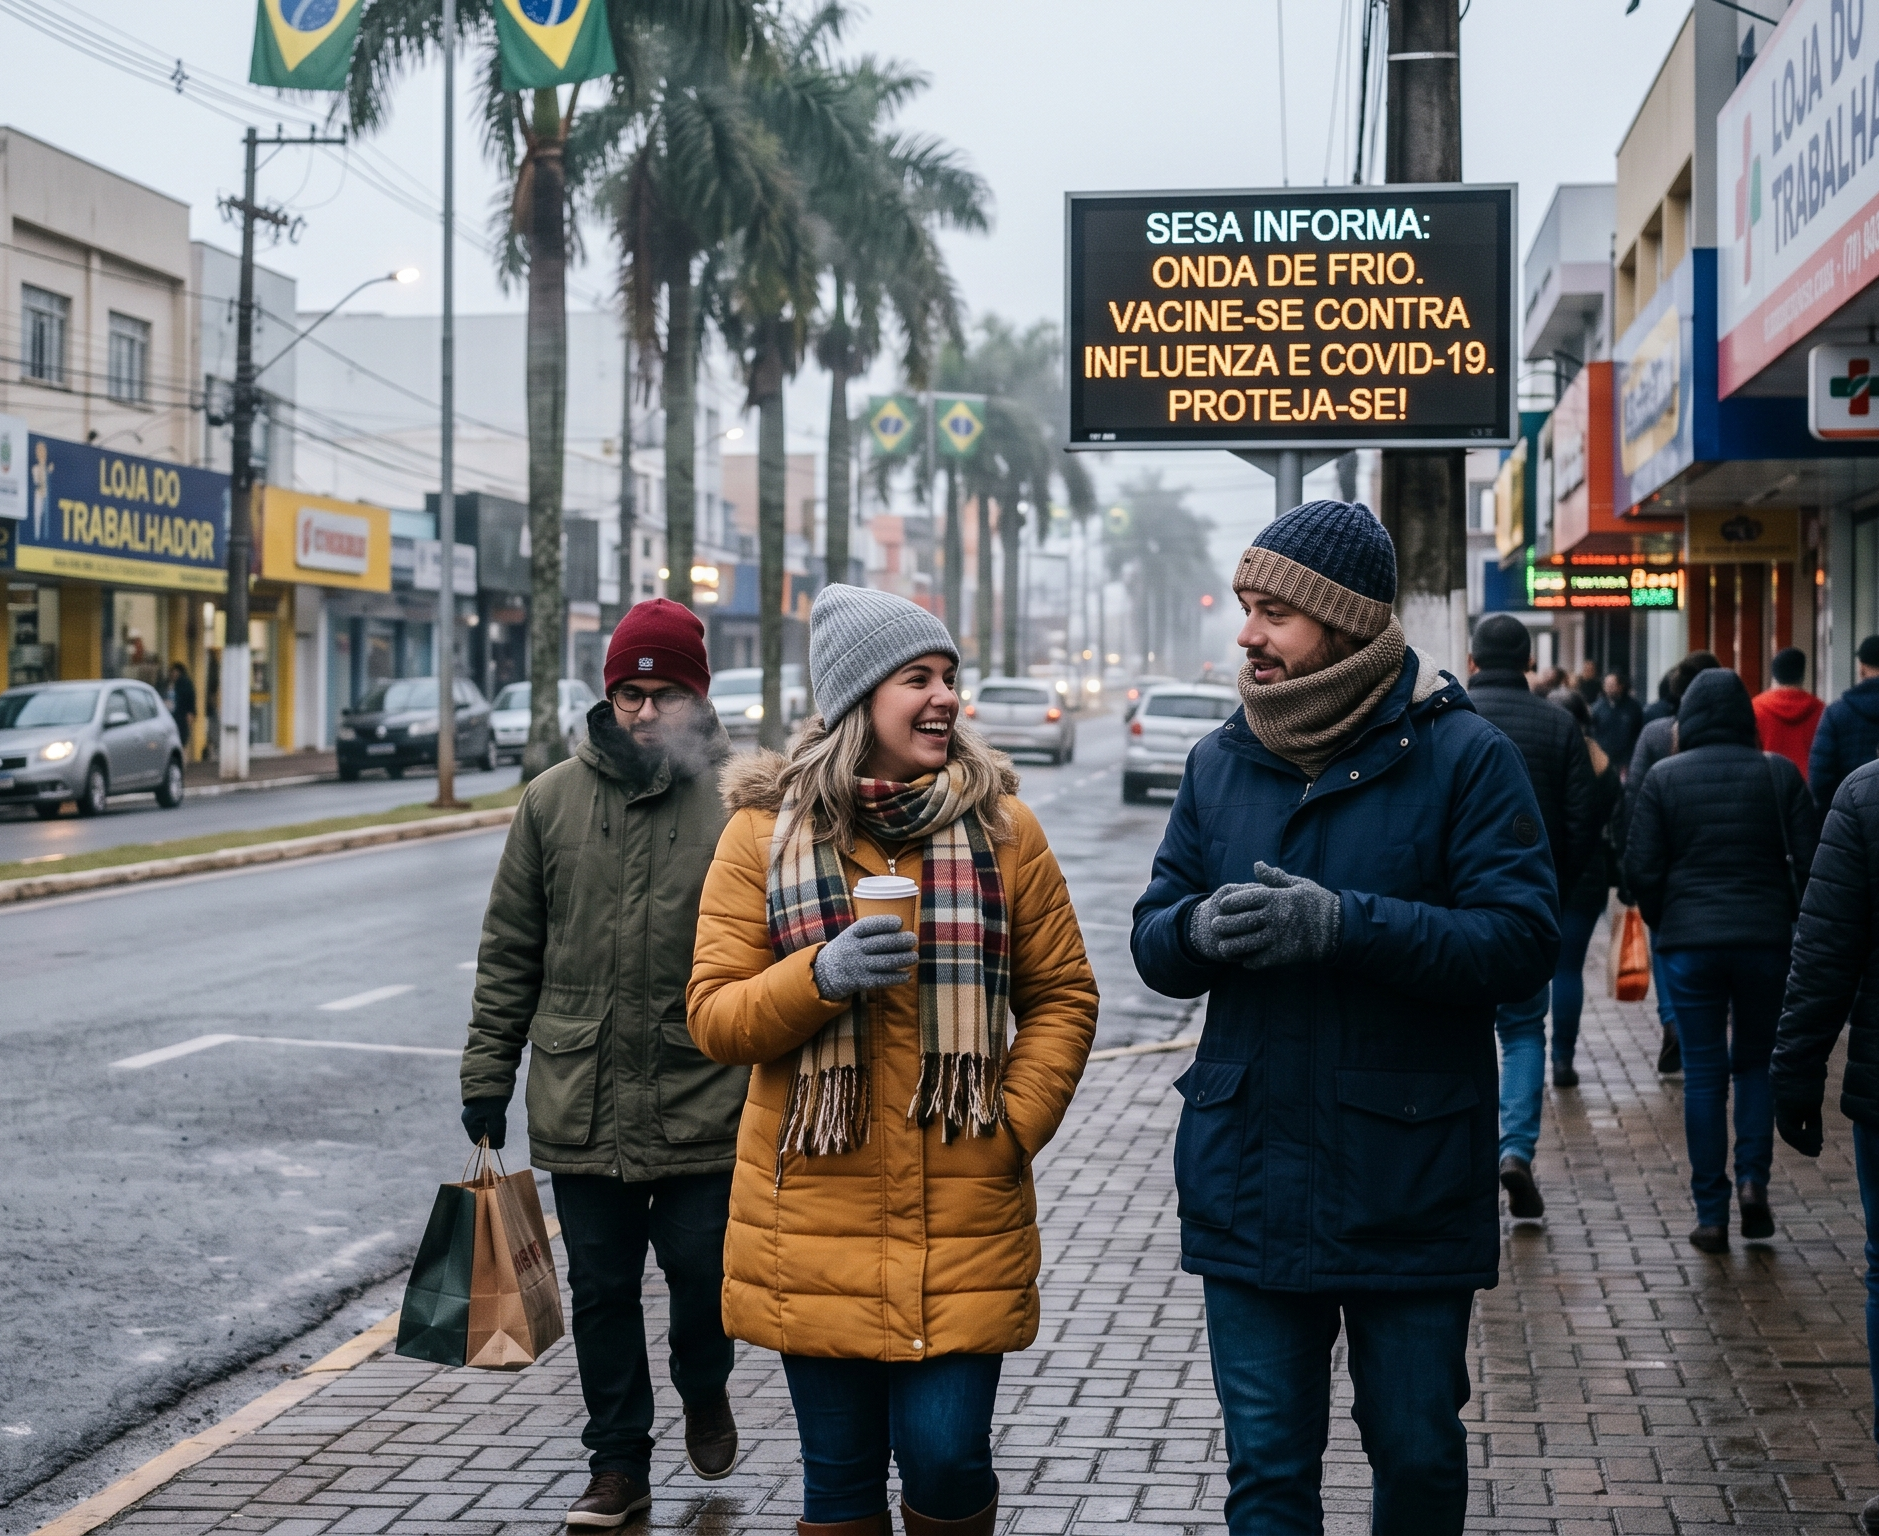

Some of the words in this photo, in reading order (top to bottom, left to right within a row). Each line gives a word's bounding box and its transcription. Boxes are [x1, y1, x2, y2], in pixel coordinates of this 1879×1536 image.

[1771, 22, 1823, 157] LOJA
[1146, 210, 1244, 244] SESA
[1253, 207, 1431, 242] INFORMA:
[1152, 254, 1259, 288] ONDA
[1267, 253, 1318, 287] DE
[1328, 251, 1424, 285] FRIO.
[1108, 299, 1305, 333] VACINE-SE
[1314, 296, 1471, 331] CONTRA
[1084, 343, 1281, 379] INFLUENZA
[1288, 343, 1312, 376] E
[1320, 340, 1495, 376] COVID-19.
[1168, 387, 1407, 422] PROTEJA-SE!
[99, 457, 150, 503] LOJA
[153, 466, 181, 509] DO
[58, 498, 215, 562] TRABALHADOR
